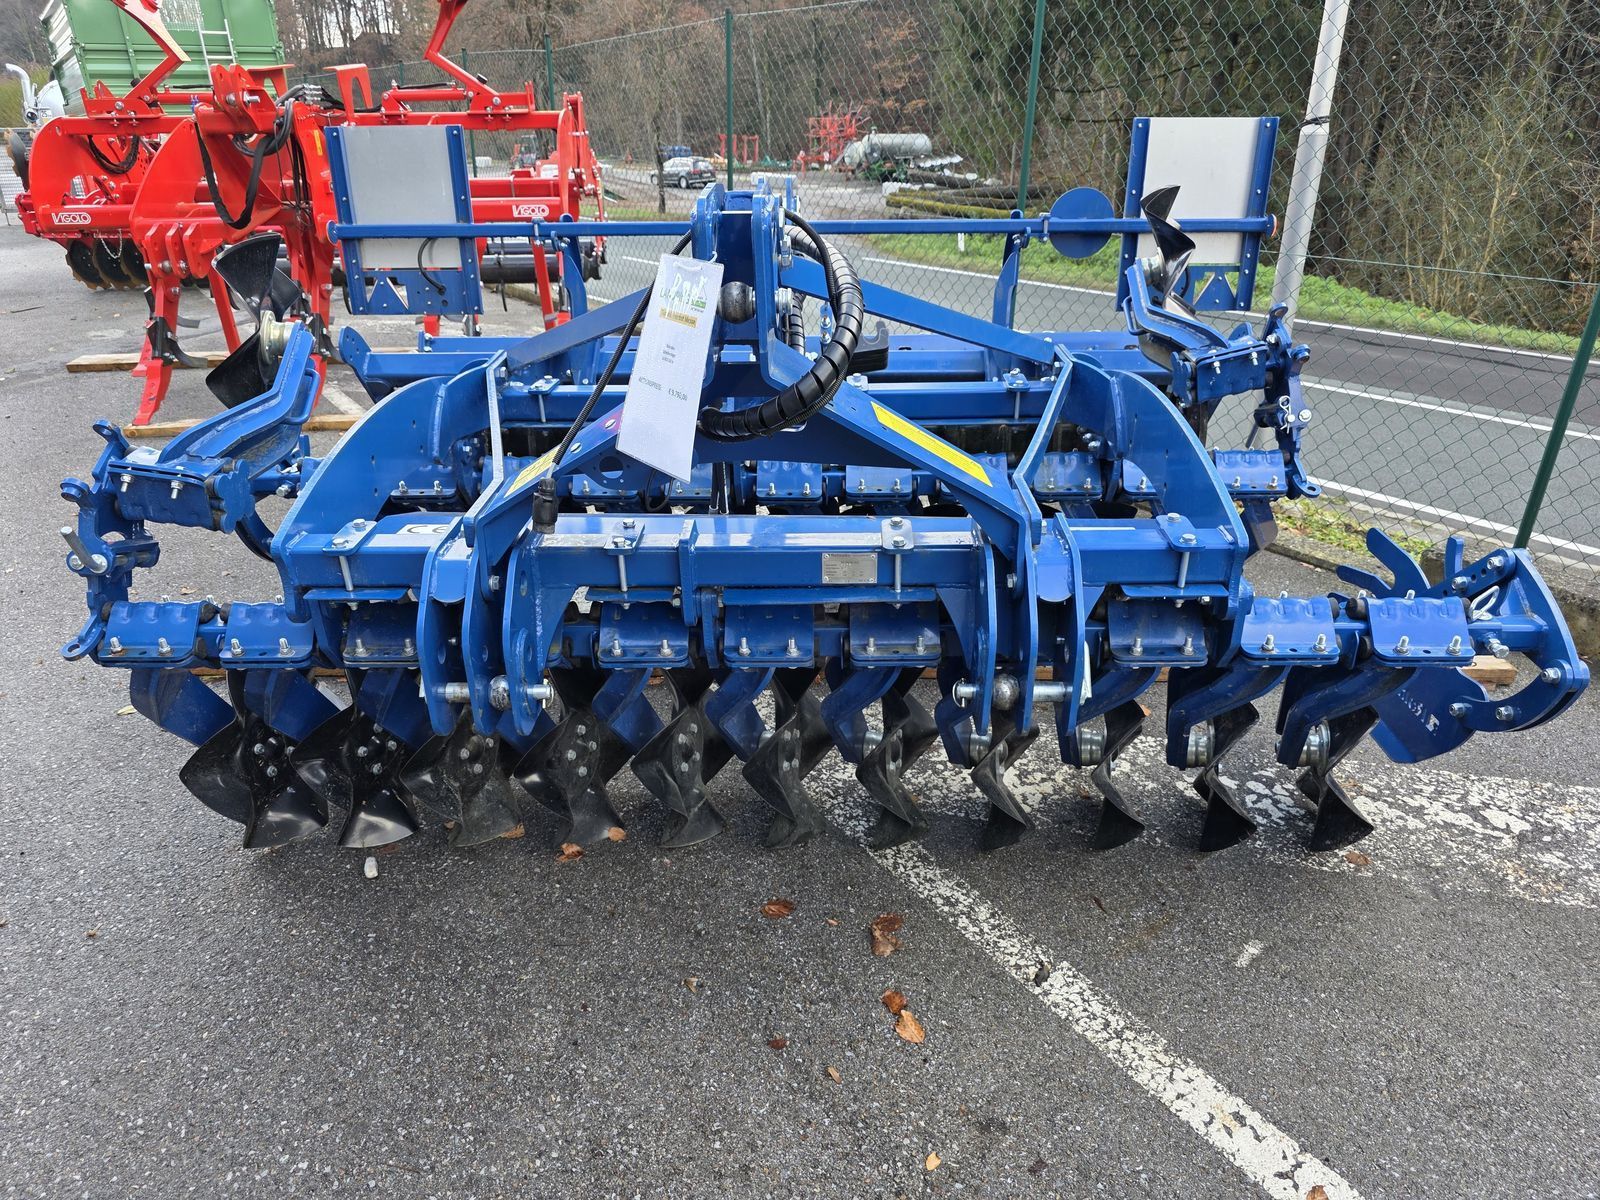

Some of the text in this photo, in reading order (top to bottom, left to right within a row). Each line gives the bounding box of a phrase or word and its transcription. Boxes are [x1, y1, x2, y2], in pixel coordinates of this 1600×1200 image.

[512, 205, 549, 217] VIGOLO
[52, 212, 91, 224] VIGOLO
[407, 525, 449, 534] CE
